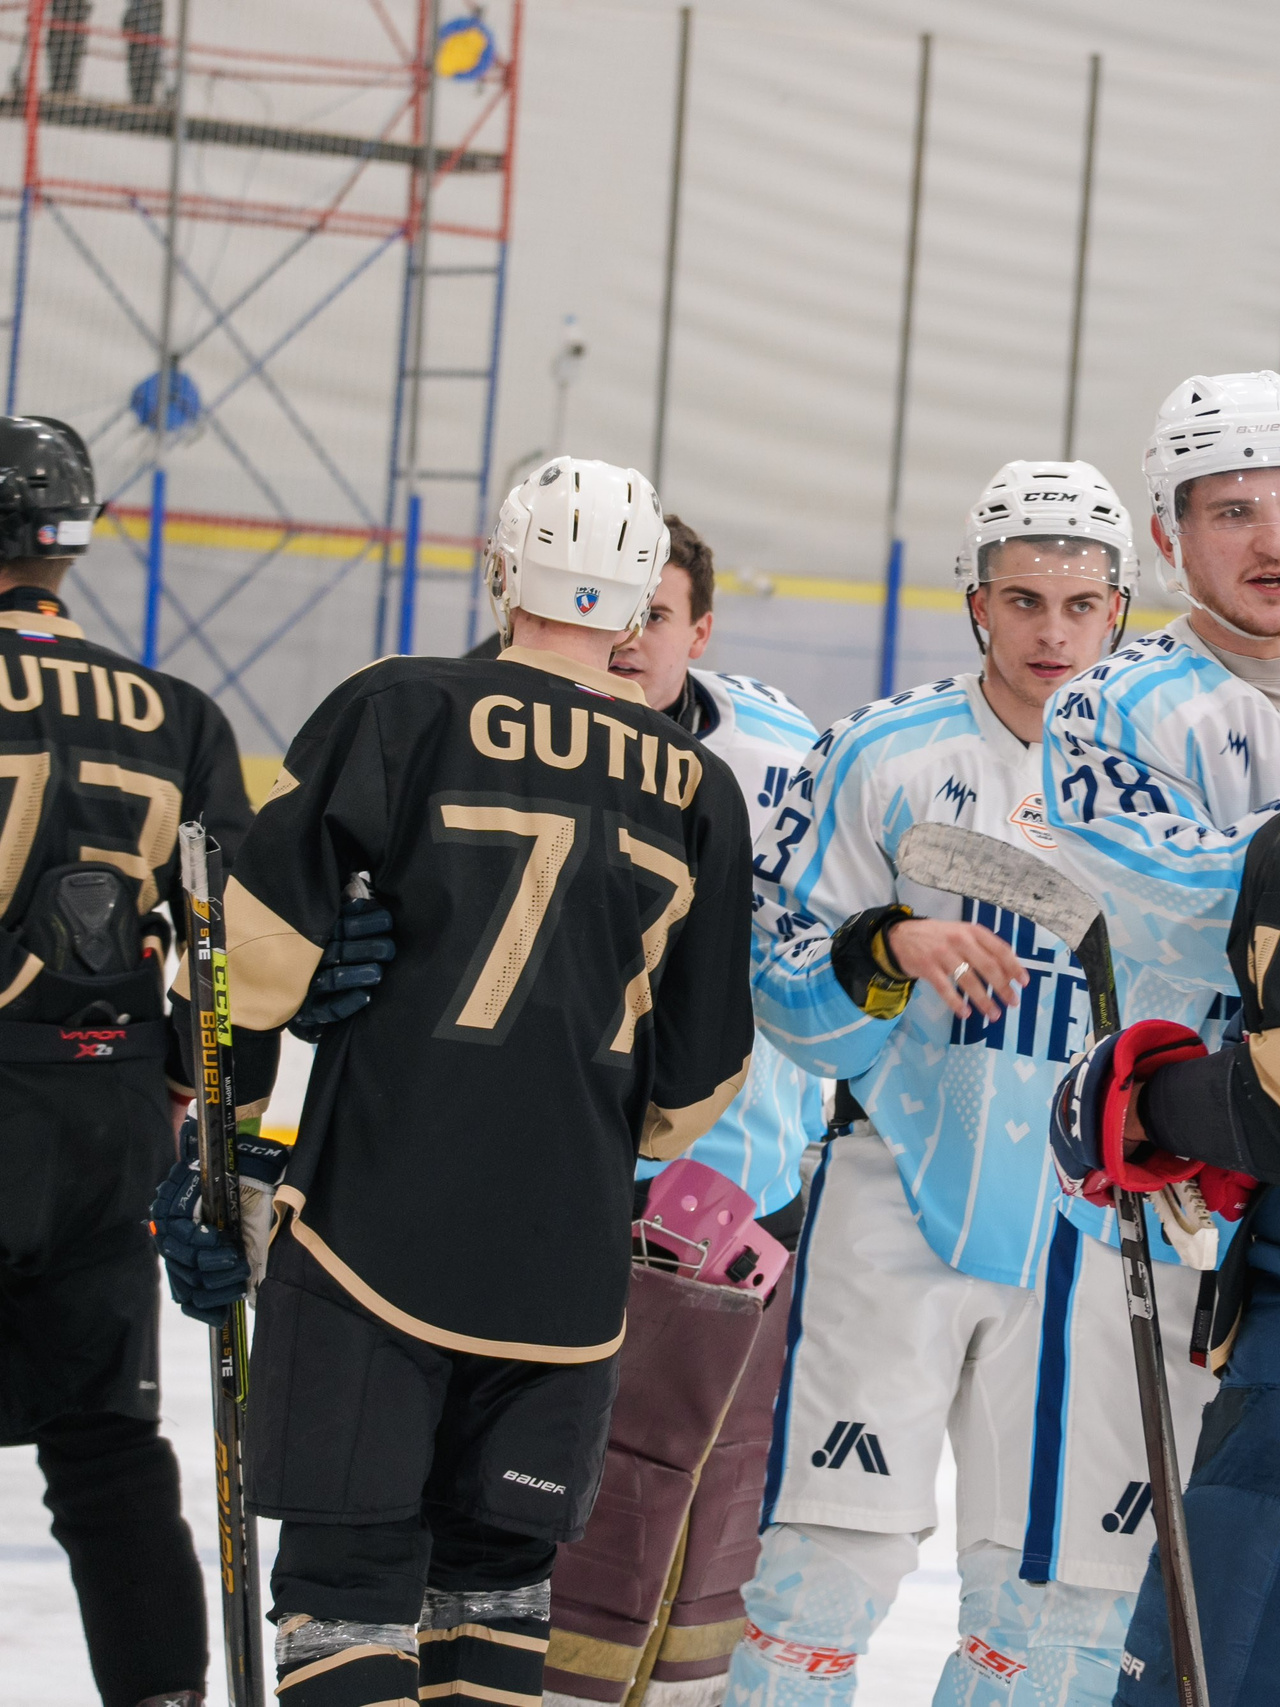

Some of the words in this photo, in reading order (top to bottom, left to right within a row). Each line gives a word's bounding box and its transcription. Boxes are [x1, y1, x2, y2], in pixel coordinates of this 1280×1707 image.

[1023, 491, 1079, 502] CCM
[0, 654, 165, 732] UTID
[469, 694, 703, 809] GUTID
[440, 804, 695, 1053] 77
[213, 964, 230, 1036] CCM
[60, 1029, 127, 1041] VAPOR
[200, 1010, 221, 1105] BAUER
[224, 1076, 232, 1107] MURPHY
[236, 1143, 283, 1158] CCM
[502, 1469, 567, 1495] BAUER
